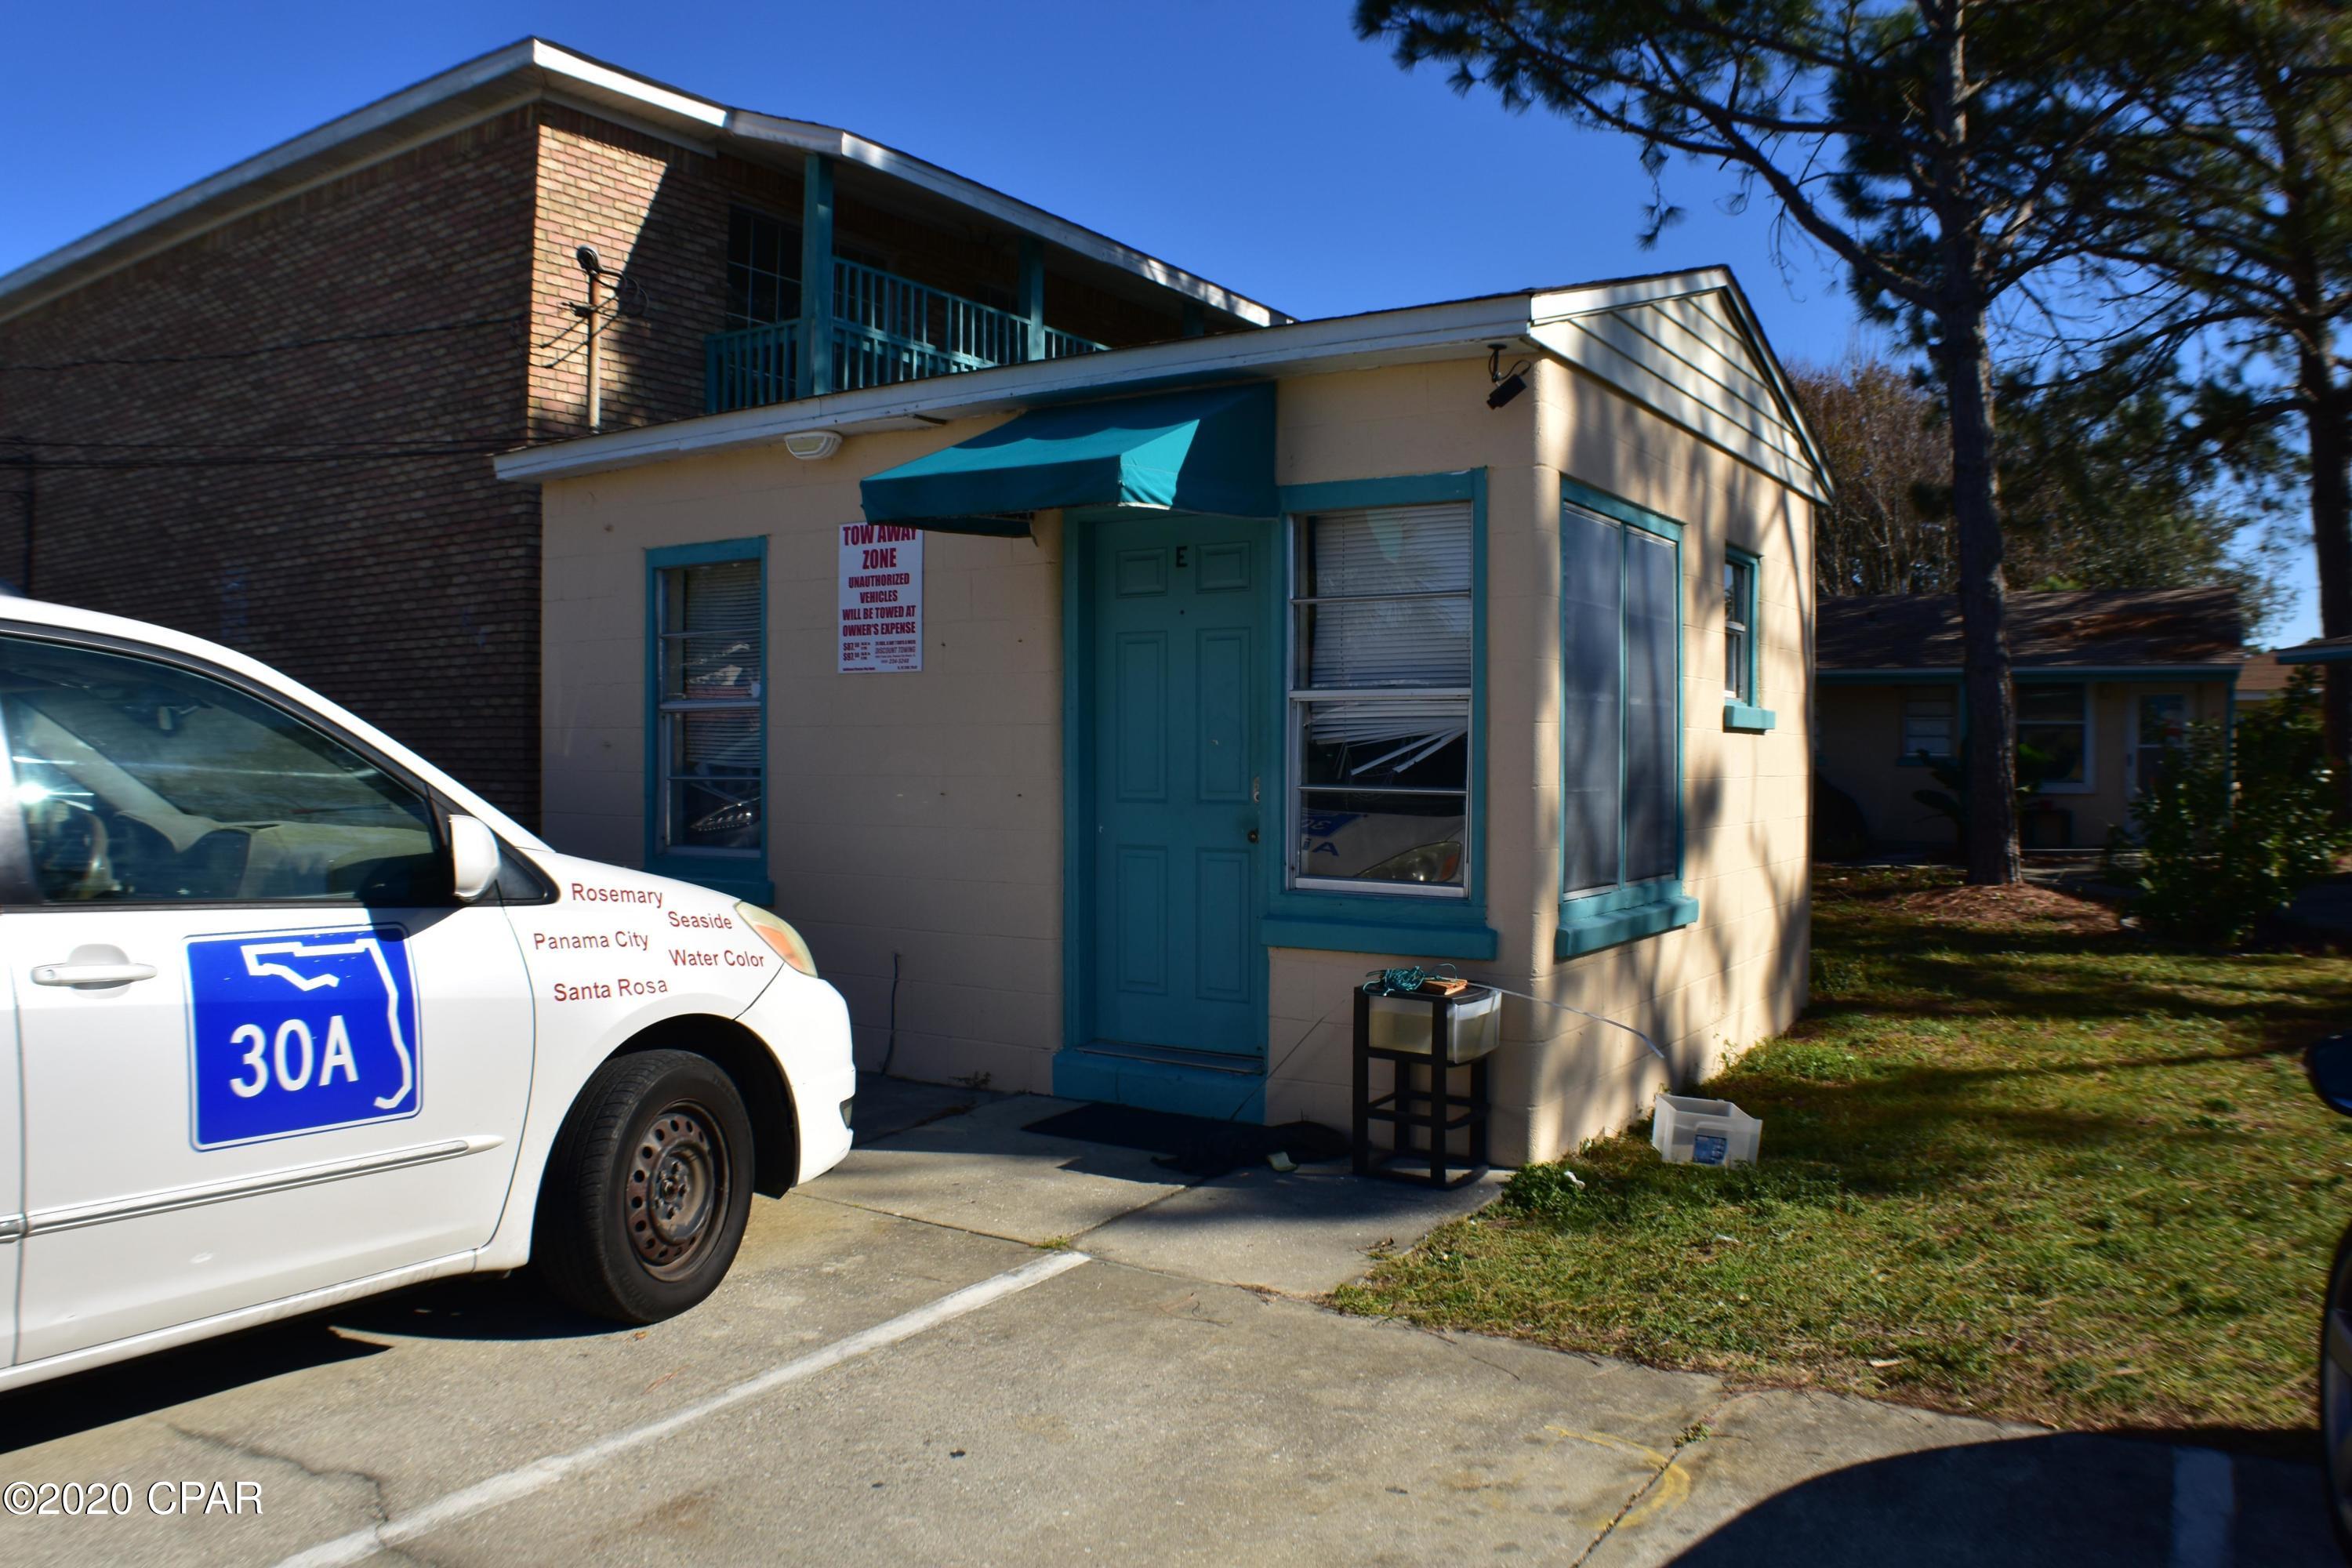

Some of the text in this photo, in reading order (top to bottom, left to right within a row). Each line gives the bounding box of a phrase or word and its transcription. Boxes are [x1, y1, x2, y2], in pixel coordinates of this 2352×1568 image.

[843, 524, 916, 546] TOW AWAY
[862, 548, 897, 569] ZONE
[1176, 546, 1188, 568] E
[848, 573, 909, 588] UNAUTHORIZED
[860, 590, 898, 604] VEHICLES
[843, 605, 916, 621] WILL BE TOWED AT
[843, 622, 916, 637] OWNER'S EXPENSE
[572, 883, 662, 909] Rosemary
[668, 911, 732, 930] Seaside
[533, 931, 648, 951] Panama City
[669, 949, 764, 967] Water Color
[554, 978, 667, 1002] Santa Rosa
[230, 1014, 359, 1098] 30A
